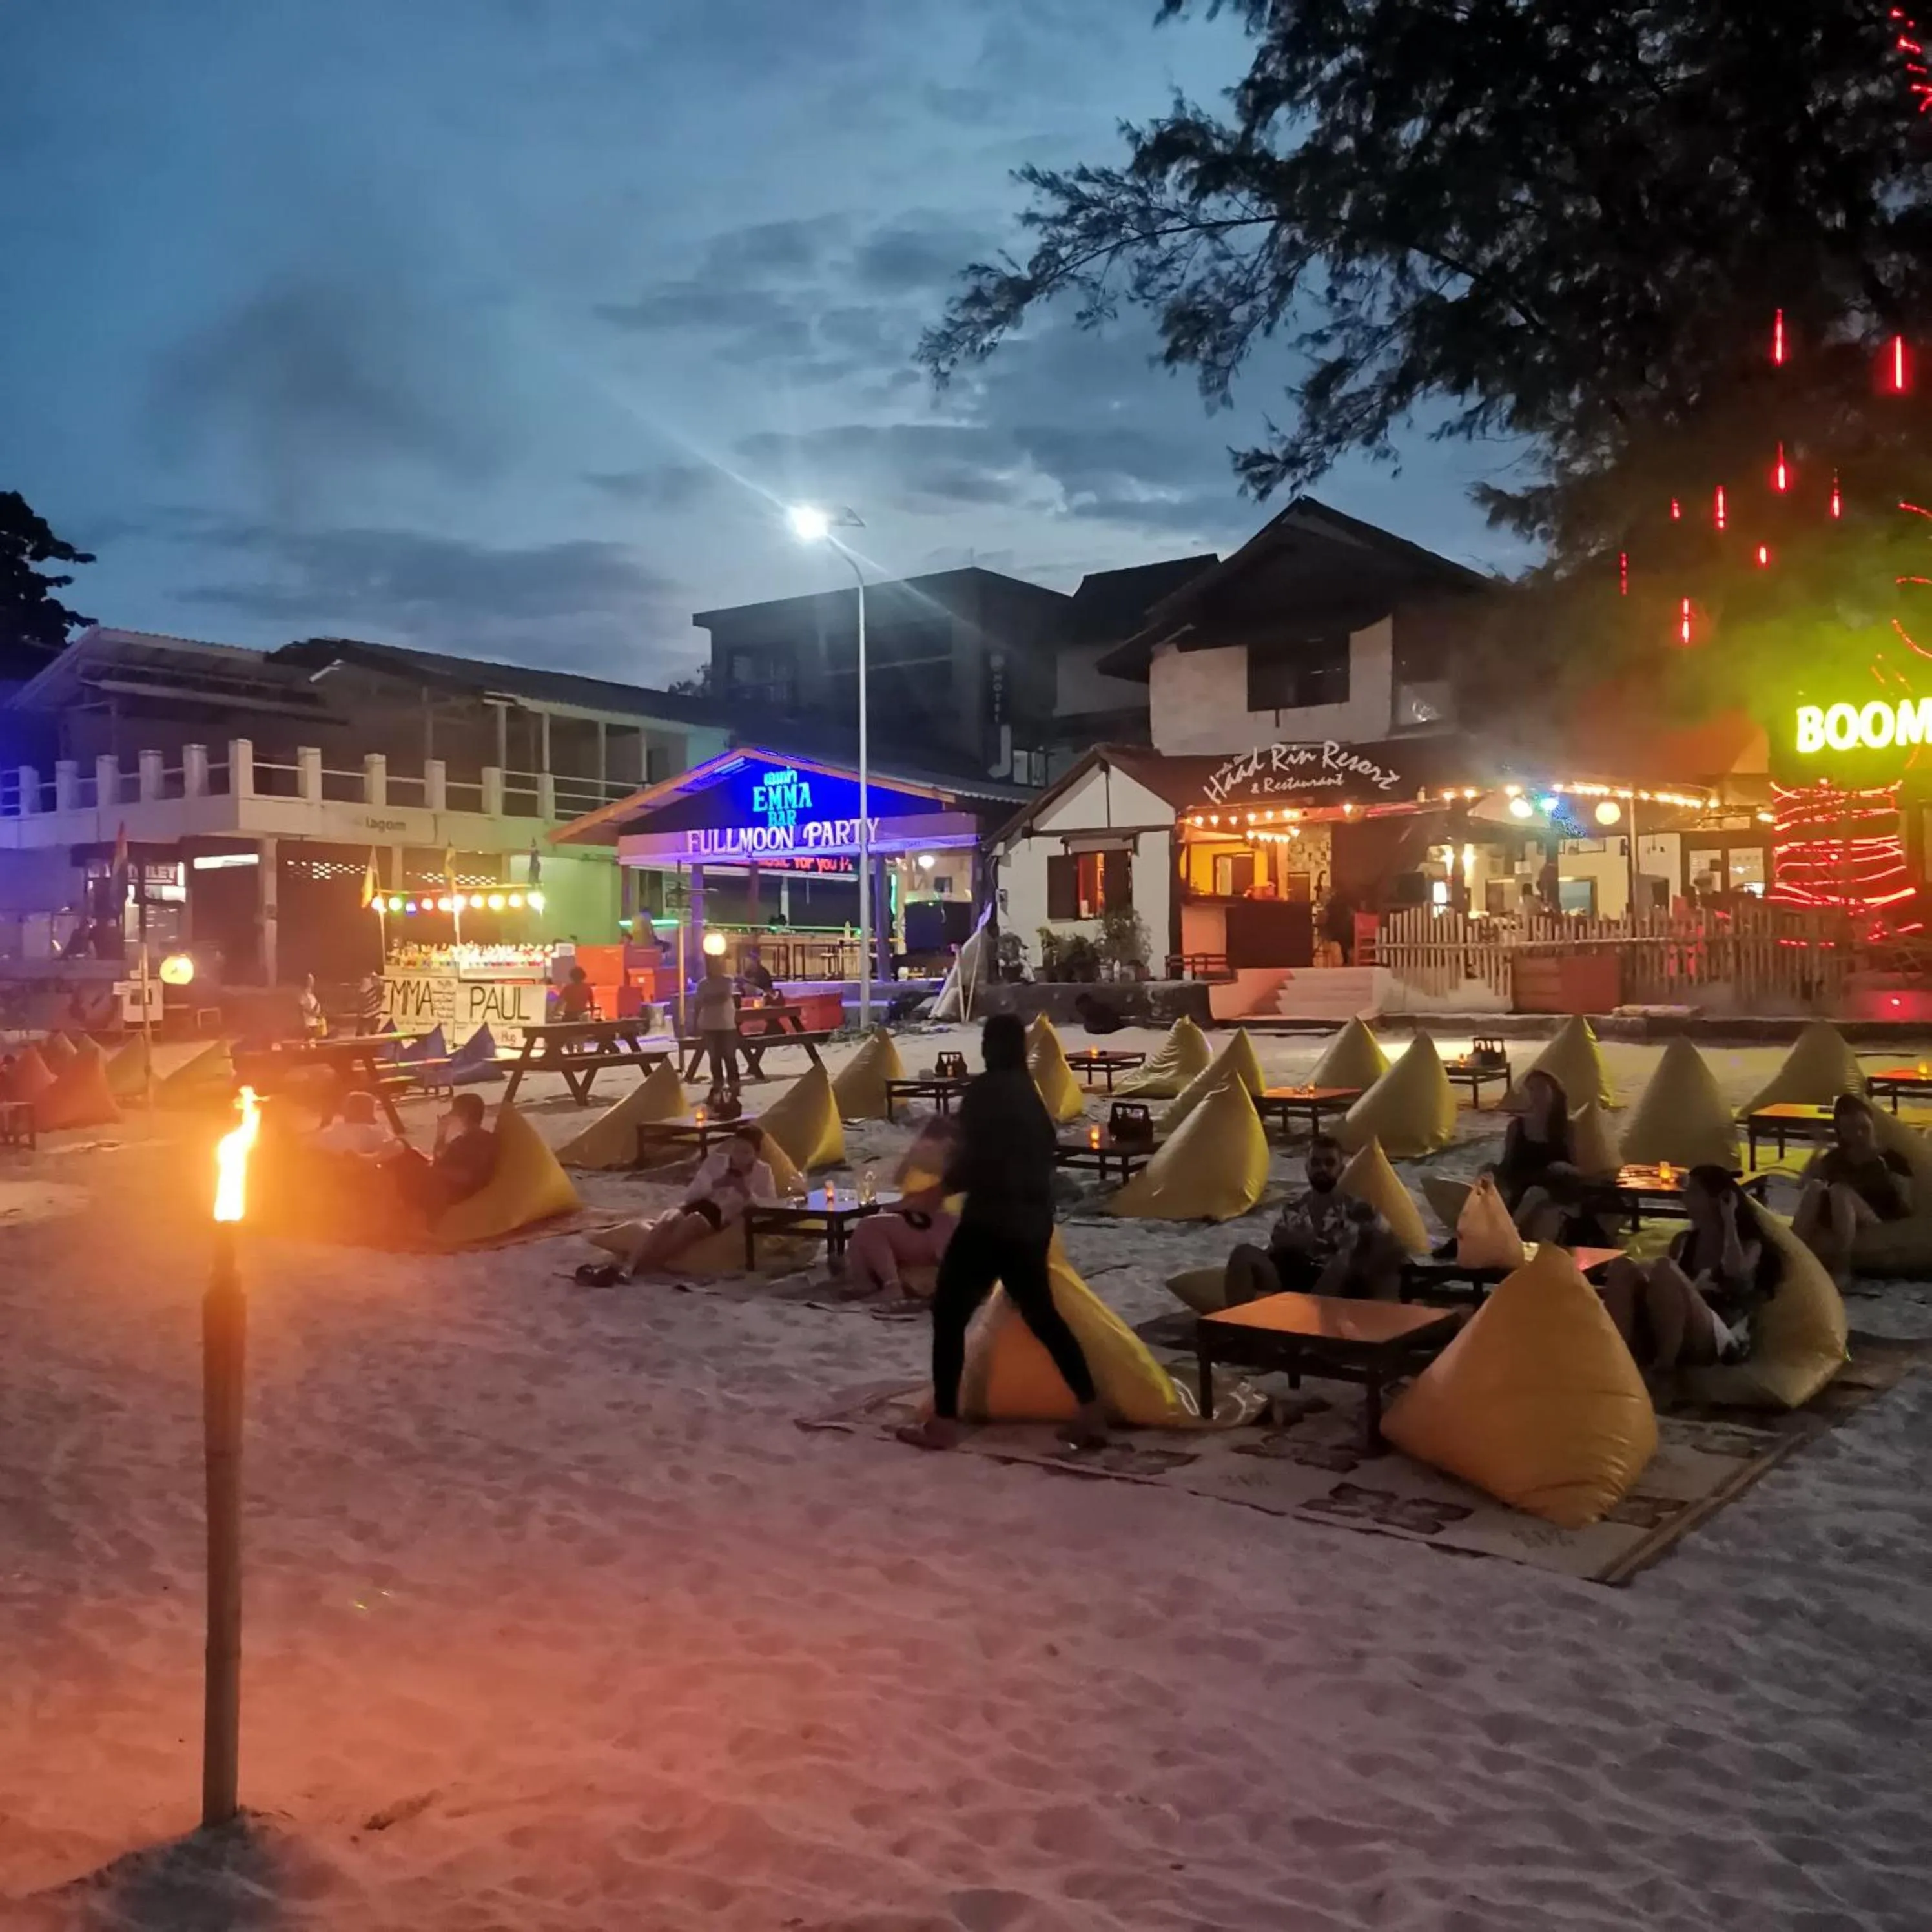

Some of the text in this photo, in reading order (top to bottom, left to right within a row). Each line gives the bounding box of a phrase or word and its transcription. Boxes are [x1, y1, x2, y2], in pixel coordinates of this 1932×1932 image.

[1203, 747, 1265, 804] Haad
[1271, 743, 1316, 771] Rin
[1322, 741, 1400, 790] Resort
[1264, 774, 1344, 792] Restaurant
[753, 782, 812, 812] EMMA
[767, 810, 797, 827] BAR
[687, 817, 879, 854] FULLMOON PARTY
[469, 986, 531, 1020] PAUL
